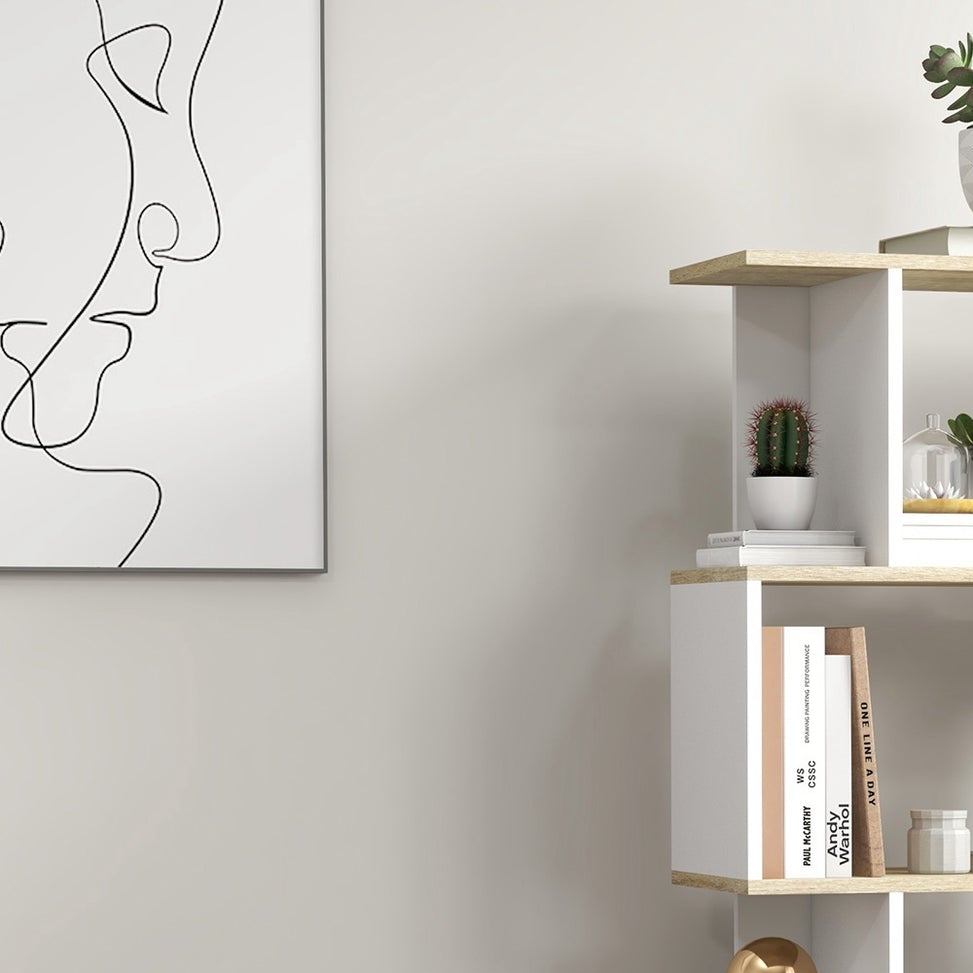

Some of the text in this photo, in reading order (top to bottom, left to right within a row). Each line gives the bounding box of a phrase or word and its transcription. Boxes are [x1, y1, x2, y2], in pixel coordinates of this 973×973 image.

[860, 702, 870, 727] ONE
[863, 734, 873, 763] LINE
[797, 768, 804, 783] WS
[808, 760, 816, 788] CSSC
[867, 781, 876, 806] DAY
[803, 806, 811, 866] PAUL McCARTHY
[827, 811, 841, 857] Andy
[839, 804, 850, 865] Warhol
